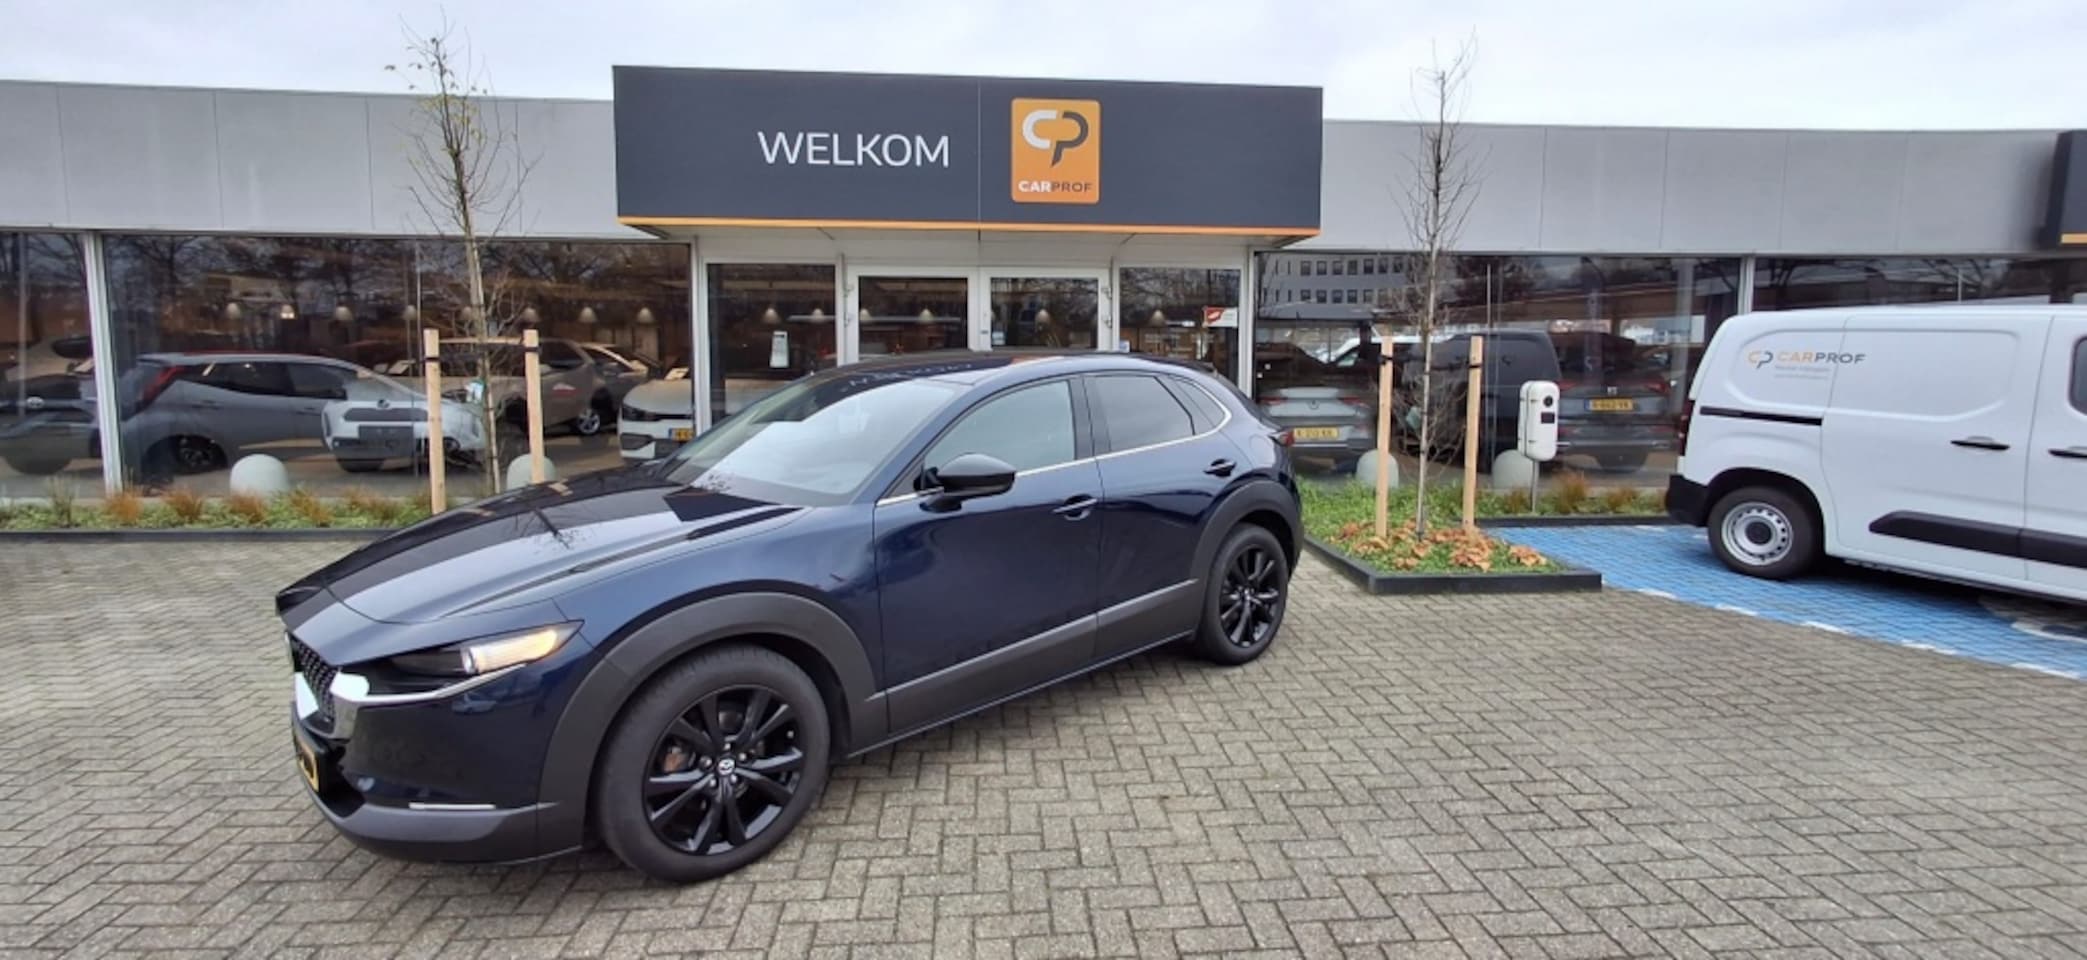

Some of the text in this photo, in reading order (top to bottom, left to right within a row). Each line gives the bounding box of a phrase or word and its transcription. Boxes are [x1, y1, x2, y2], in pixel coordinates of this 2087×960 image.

[757, 131, 949, 167] WELKOM
[1018, 181, 1092, 193] CARPROF
[1777, 351, 1867, 364] CARPROF
